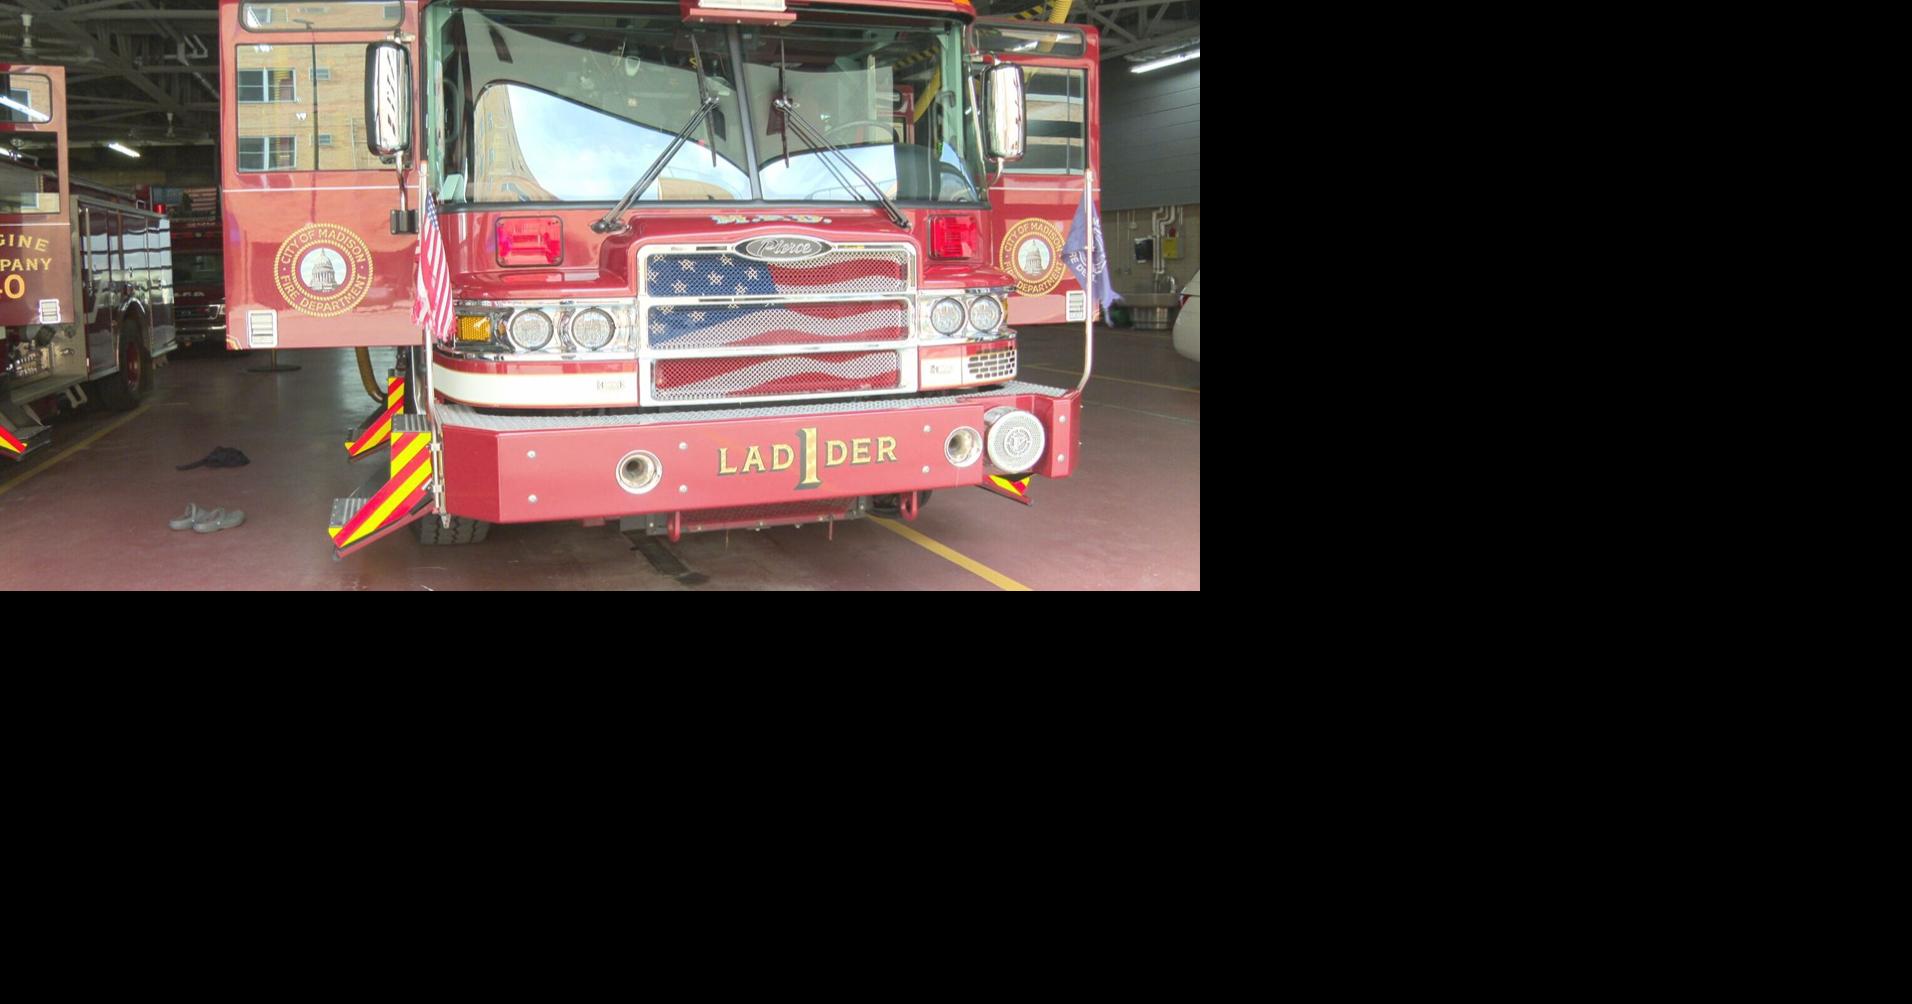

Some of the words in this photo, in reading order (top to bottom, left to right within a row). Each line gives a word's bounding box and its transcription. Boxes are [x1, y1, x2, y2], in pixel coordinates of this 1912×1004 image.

[281, 240, 299, 264] CITY
[299, 230, 315, 243] OF
[319, 229, 366, 263] MADISON
[757, 238, 812, 257] Pierce
[1004, 231, 1019, 252] CITY
[1018, 223, 1029, 234] OF
[1031, 222, 1063, 252] MADISON
[0, 257, 52, 272] PANY
[1017, 261, 1063, 293] DEPARTMENT
[0, 273, 25, 299] 0
[280, 275, 300, 300] FIRE
[300, 274, 367, 312] DEPARTMENT
